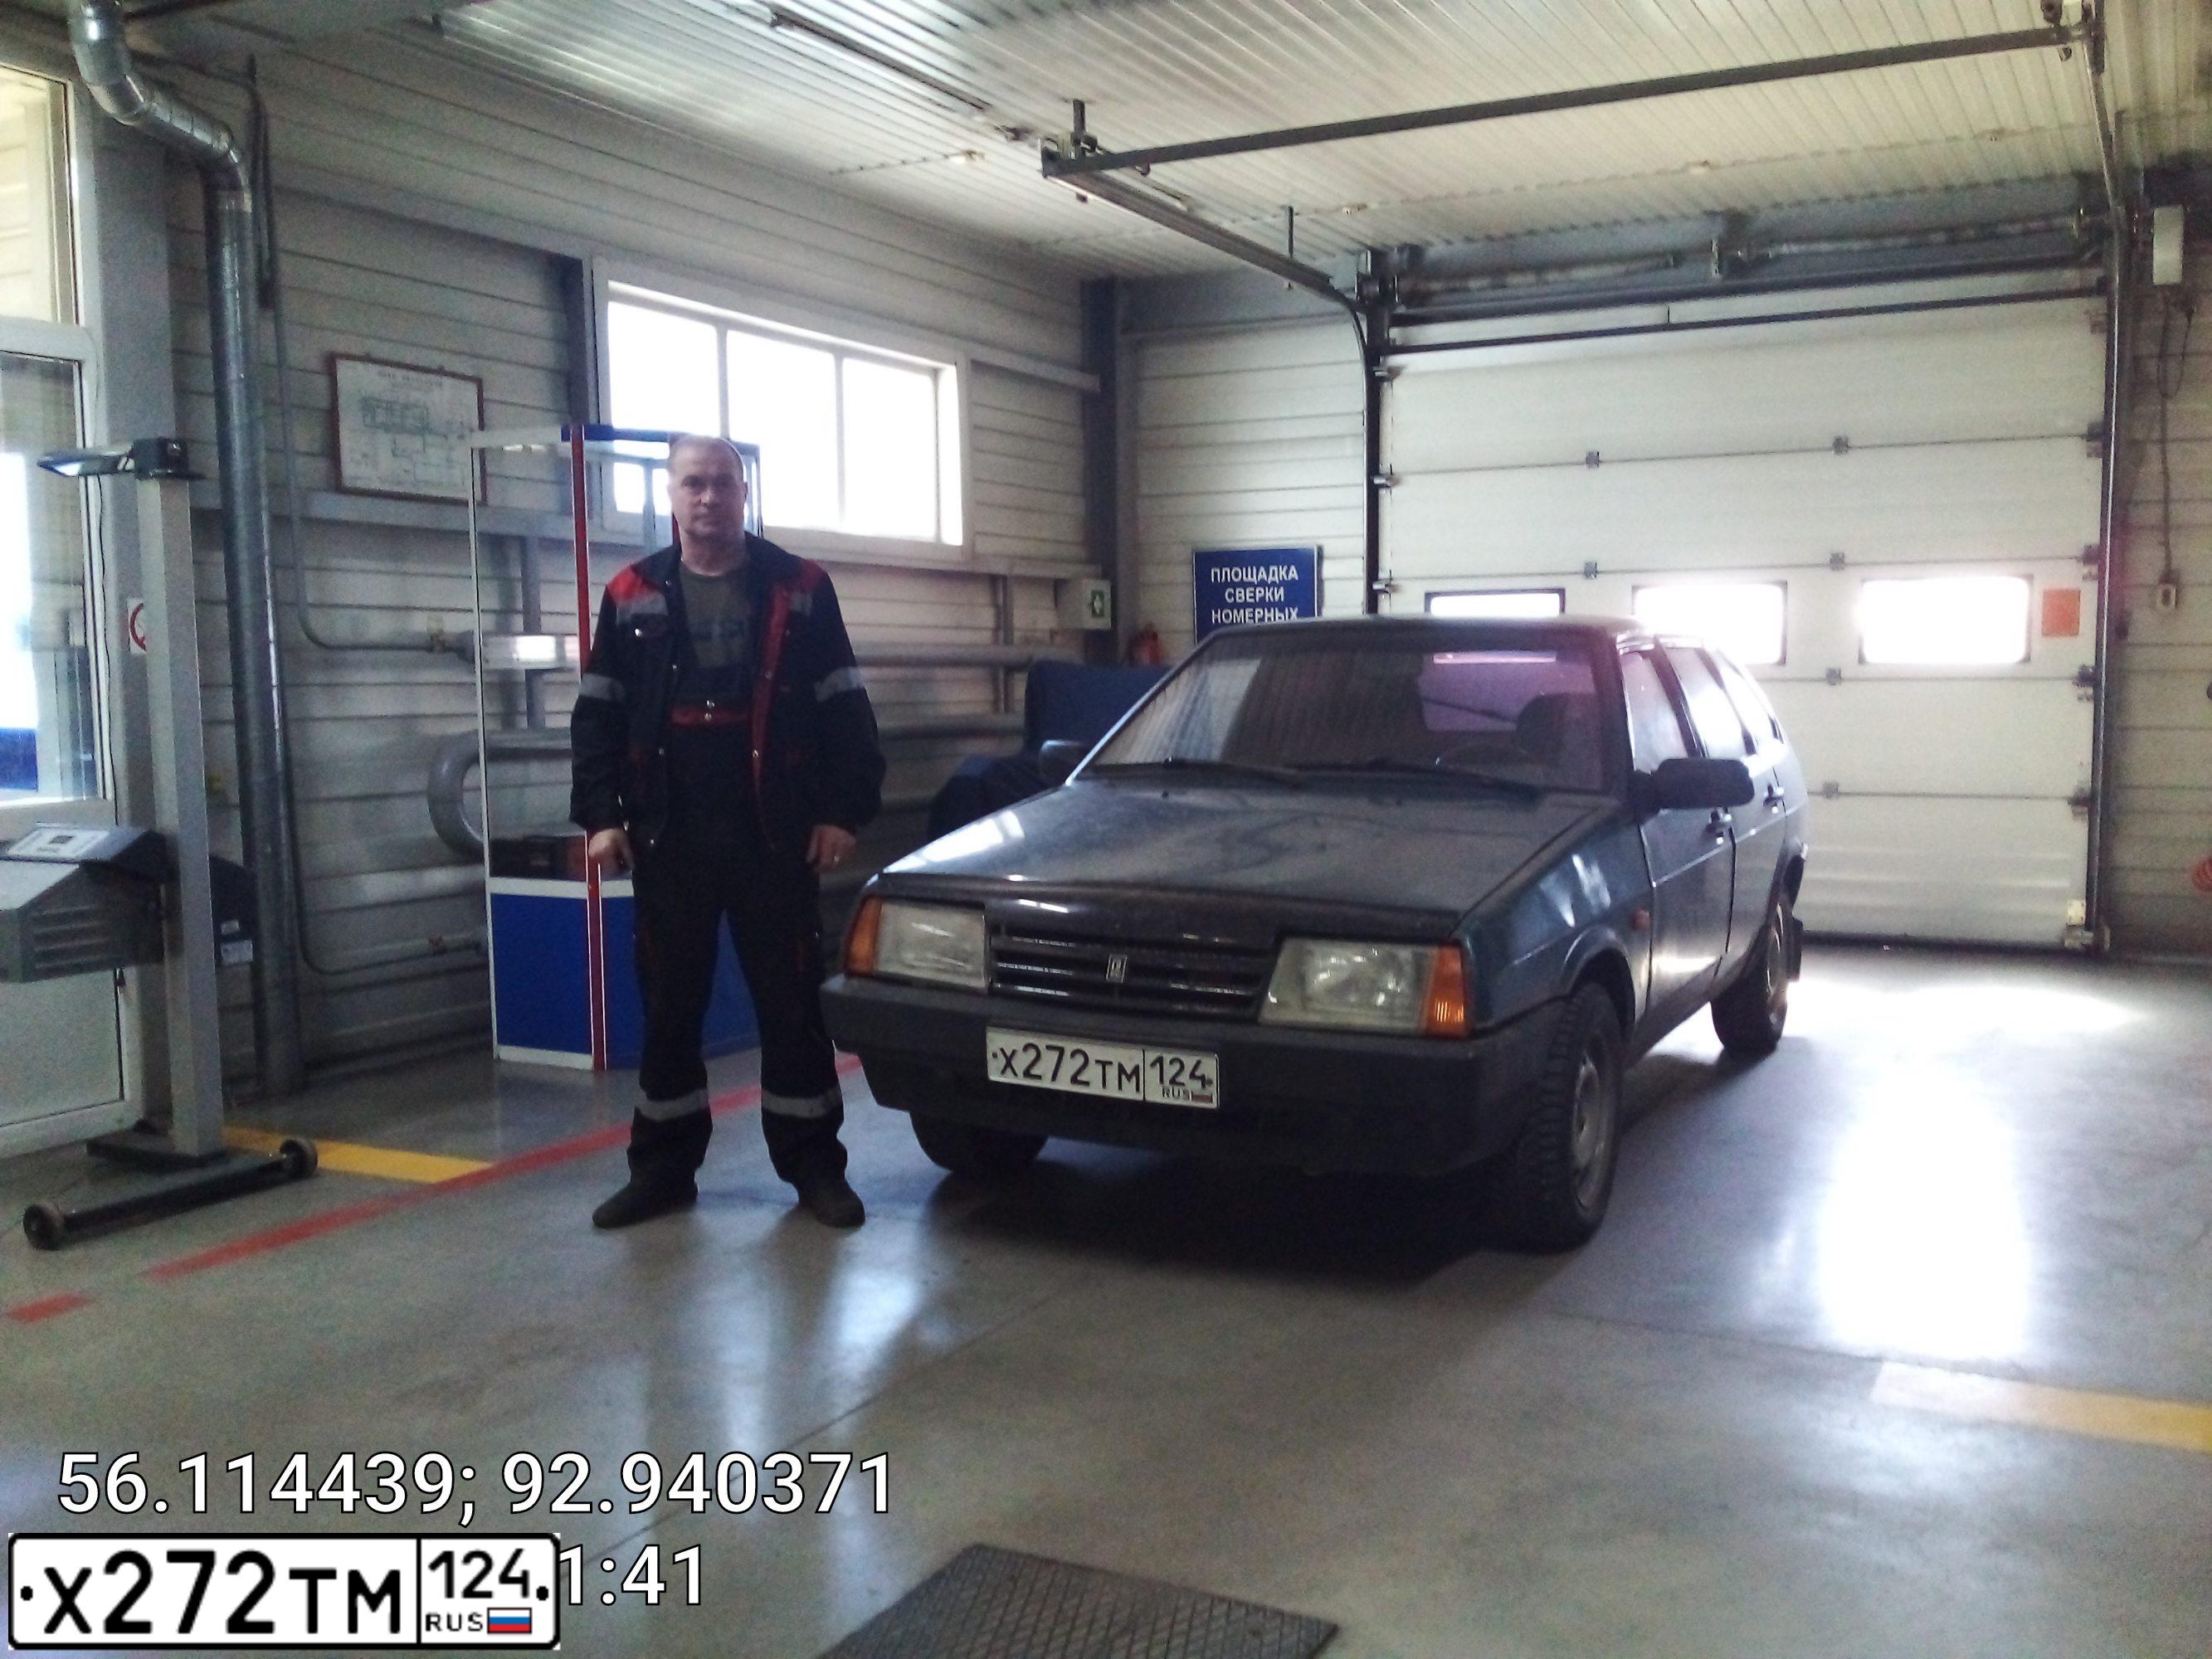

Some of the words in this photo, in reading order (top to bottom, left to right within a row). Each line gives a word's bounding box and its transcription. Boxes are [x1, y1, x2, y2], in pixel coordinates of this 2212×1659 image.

[1211, 564, 1298, 585] ПЛОЩАДКА
[1225, 586, 1284, 604] СВЕРКИ
[1211, 606, 1298, 624] НОМЕРНЫХ
[1150, 1055, 1206, 1088] 124
